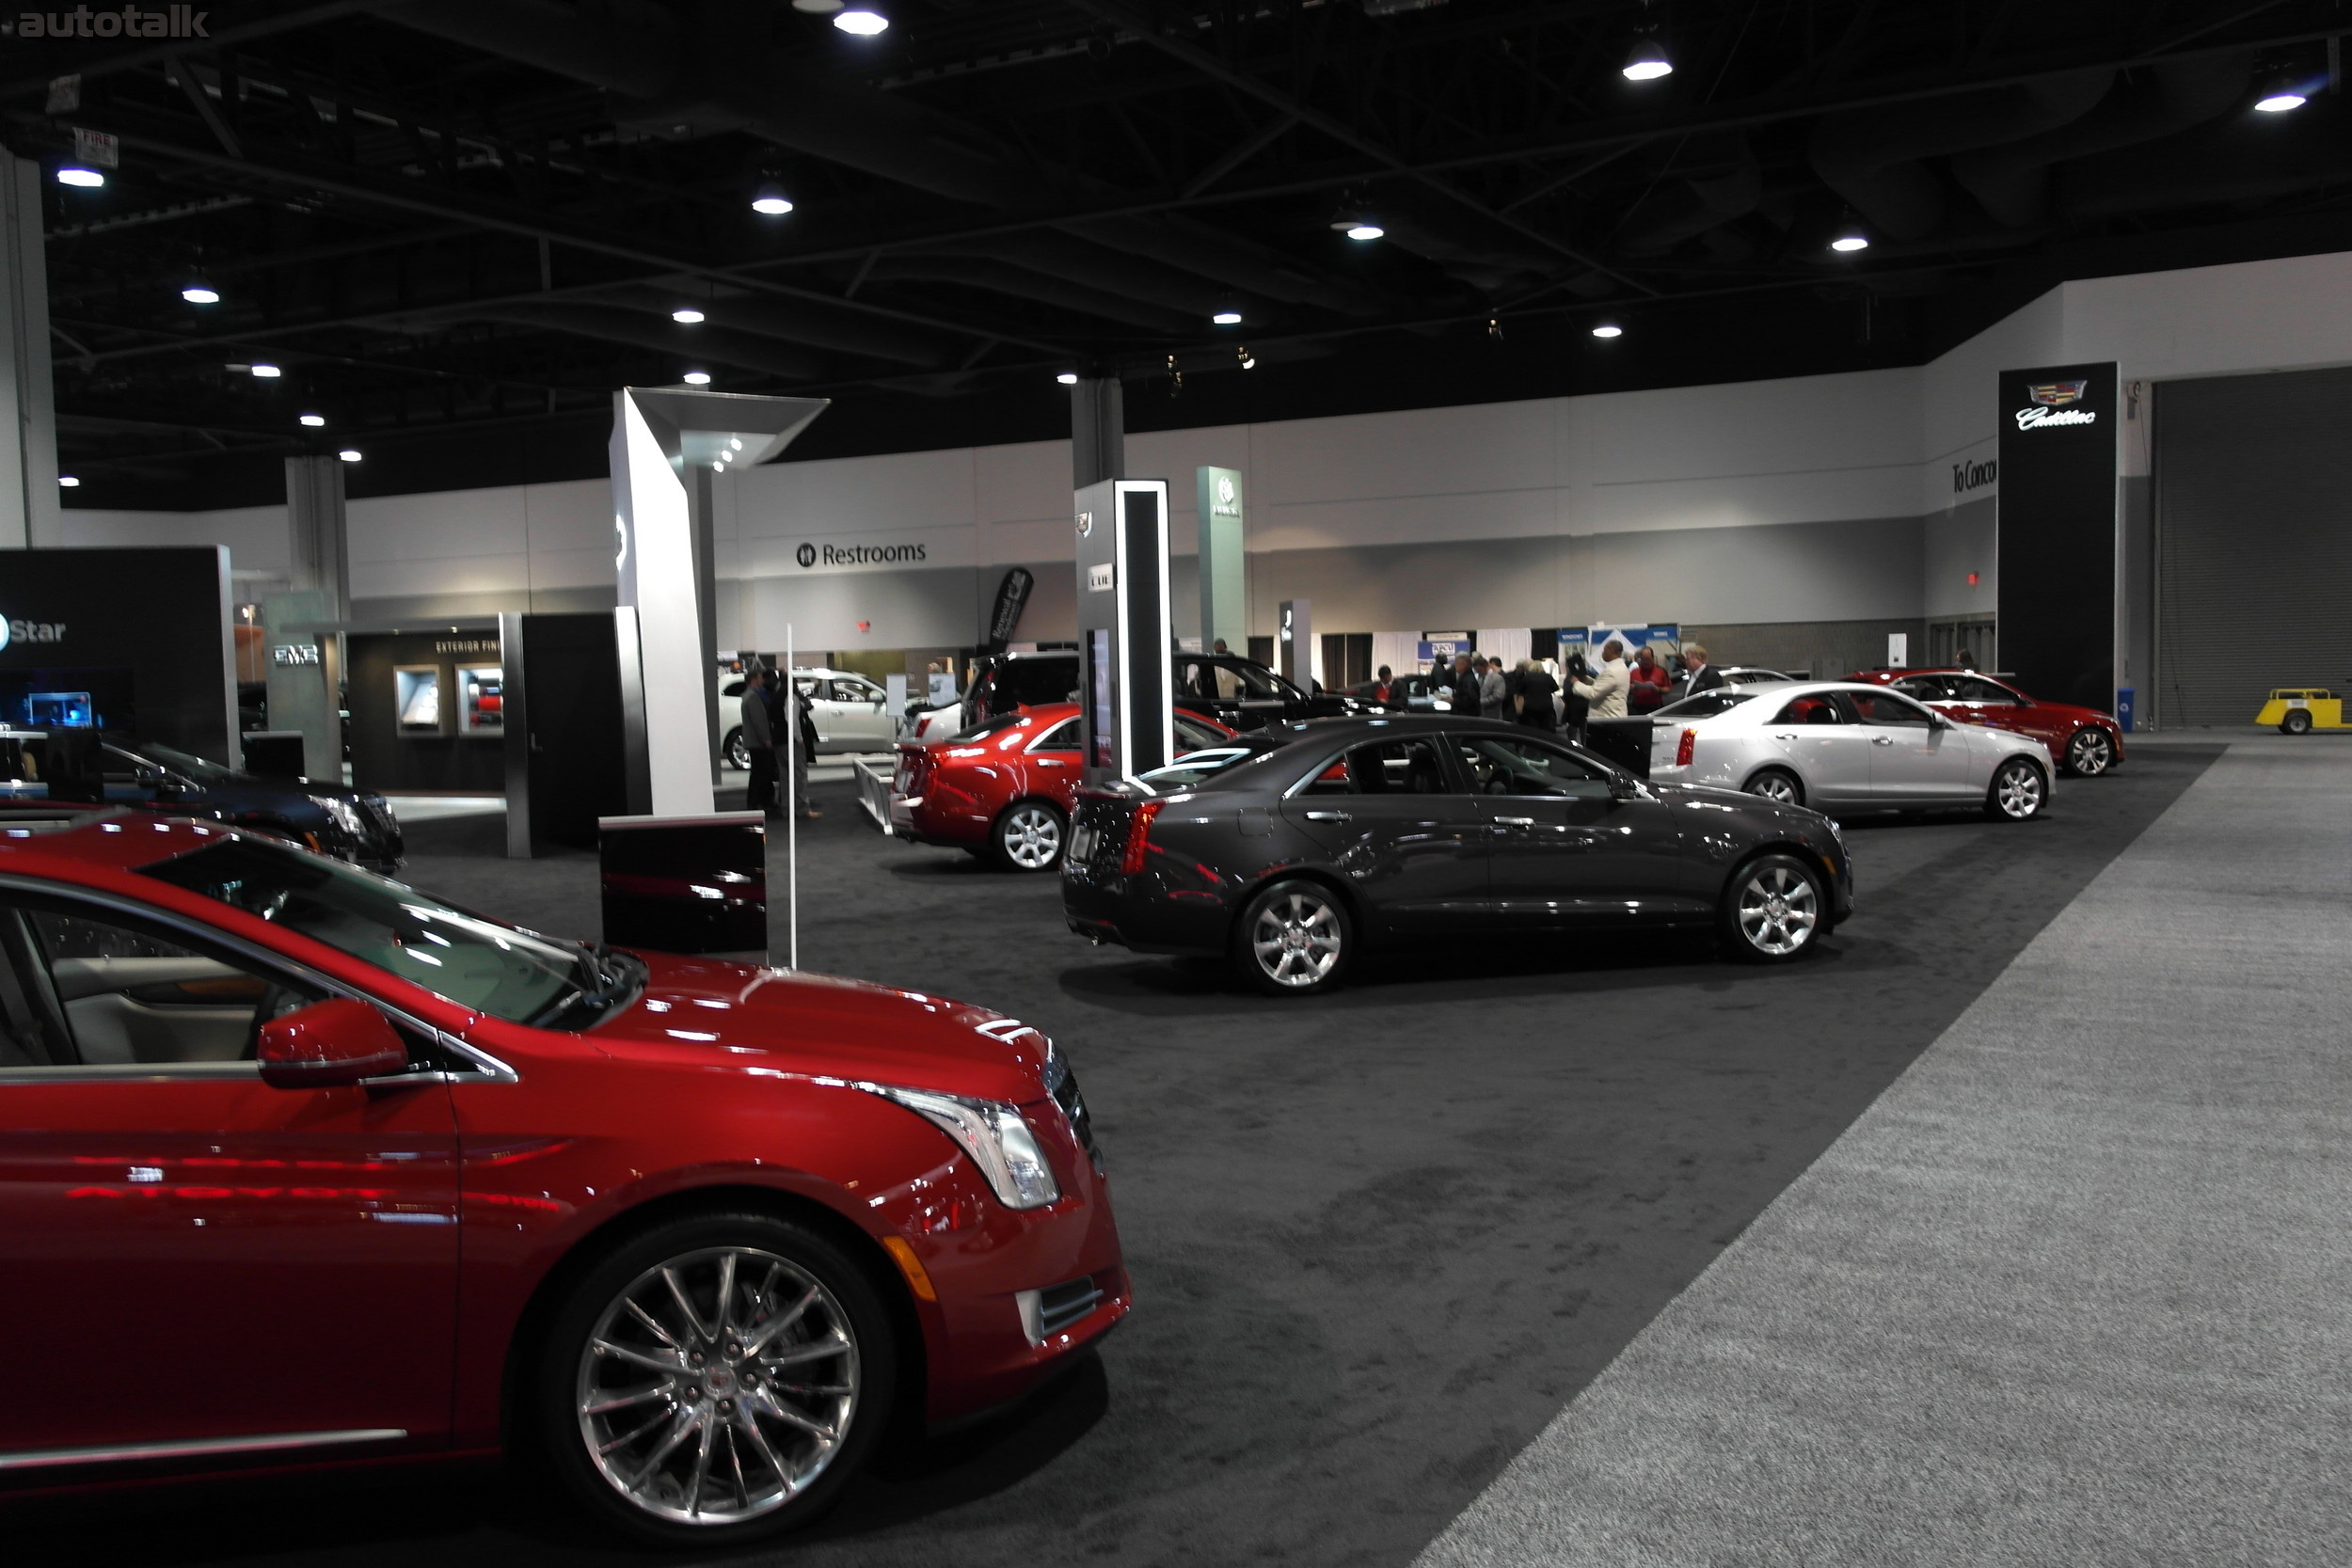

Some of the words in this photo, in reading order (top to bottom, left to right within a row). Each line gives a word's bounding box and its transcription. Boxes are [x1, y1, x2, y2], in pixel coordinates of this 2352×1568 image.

[83, 132, 111, 146] FIRE
[2015, 406, 2096, 431] Cadillac
[1952, 464, 1963, 493] To
[822, 544, 926, 565] Restrooms
[9, 619, 67, 643] Star
[436, 641, 479, 654] EXTERIOR
